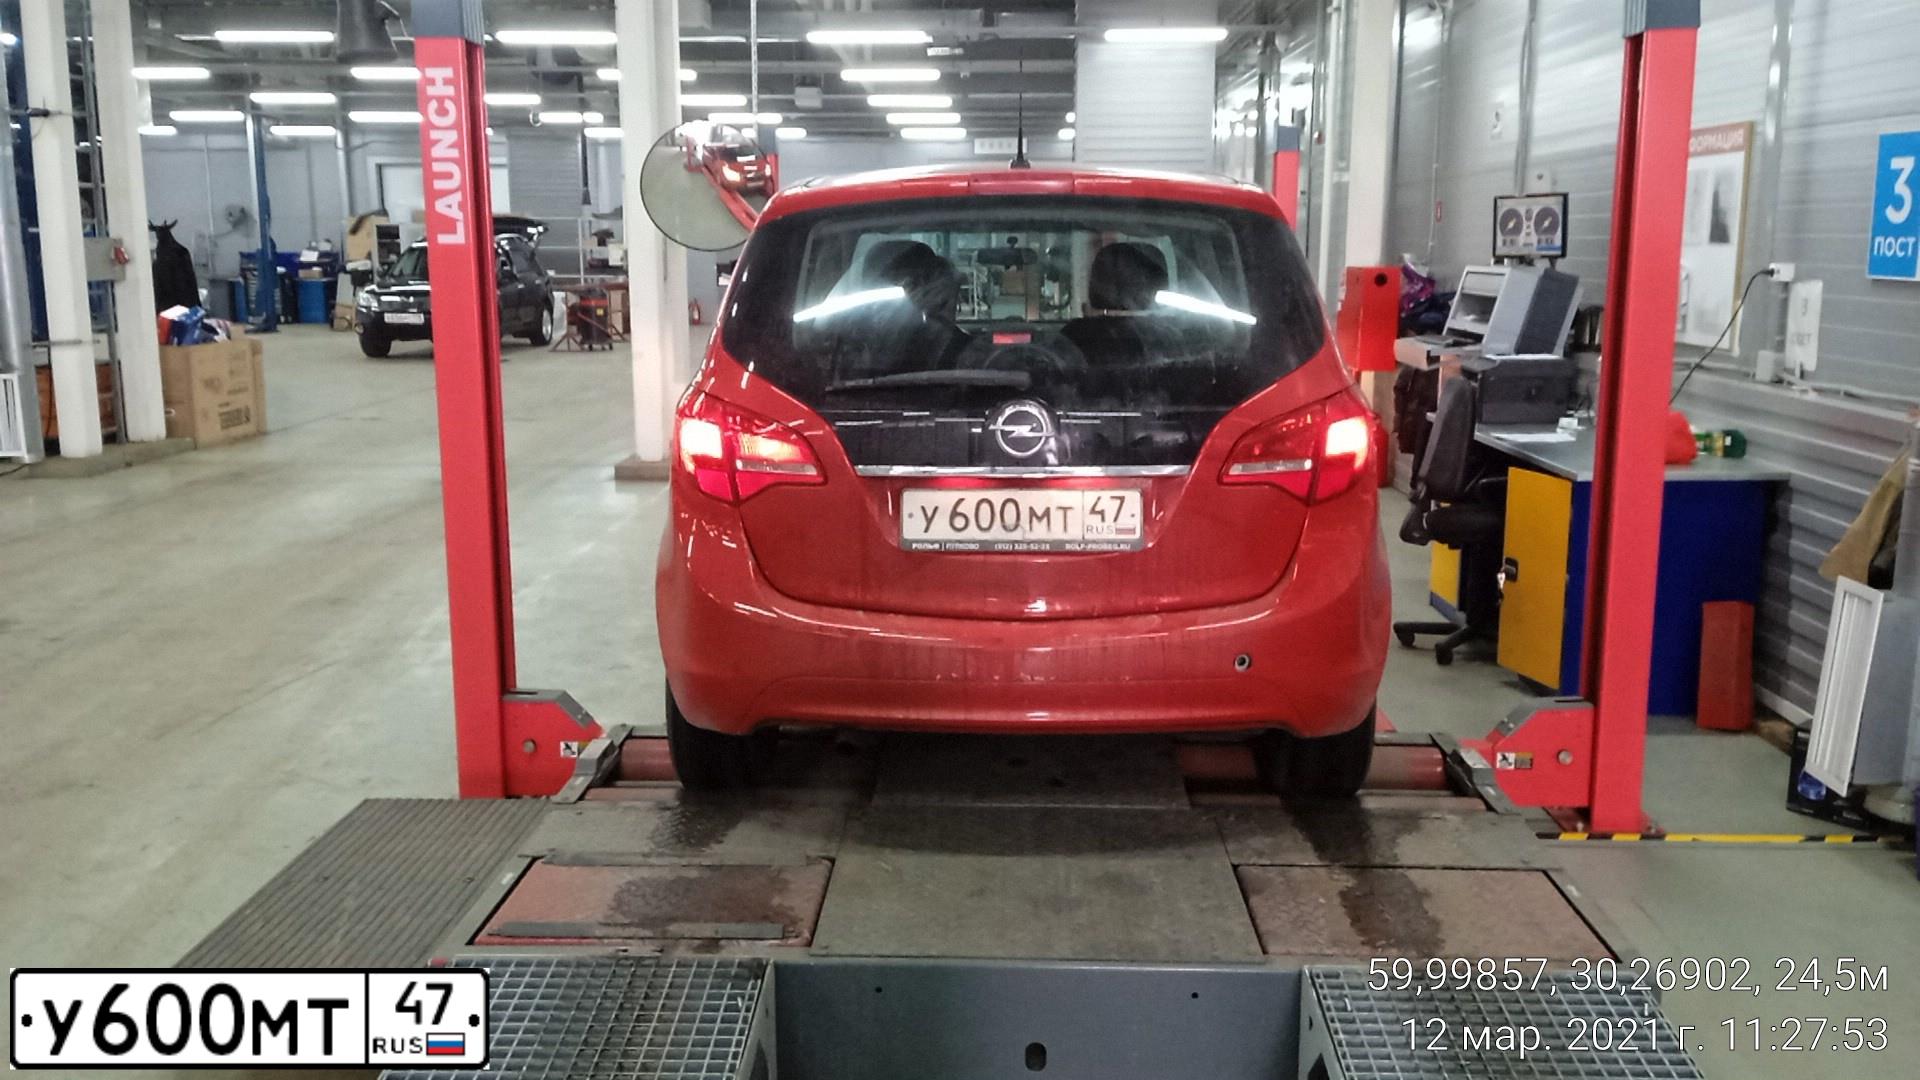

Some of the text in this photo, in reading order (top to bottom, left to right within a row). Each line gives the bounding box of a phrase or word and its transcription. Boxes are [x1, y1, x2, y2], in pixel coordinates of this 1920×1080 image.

[1689, 128, 1745, 151] ФОРМАЦИЯ
[425, 67, 465, 245] LAUNCH
[1885, 156, 1916, 224] 3
[1873, 236, 1916, 258] ПОСТ
[1089, 495, 1126, 523] 47
[1086, 524, 1114, 535] RUS
